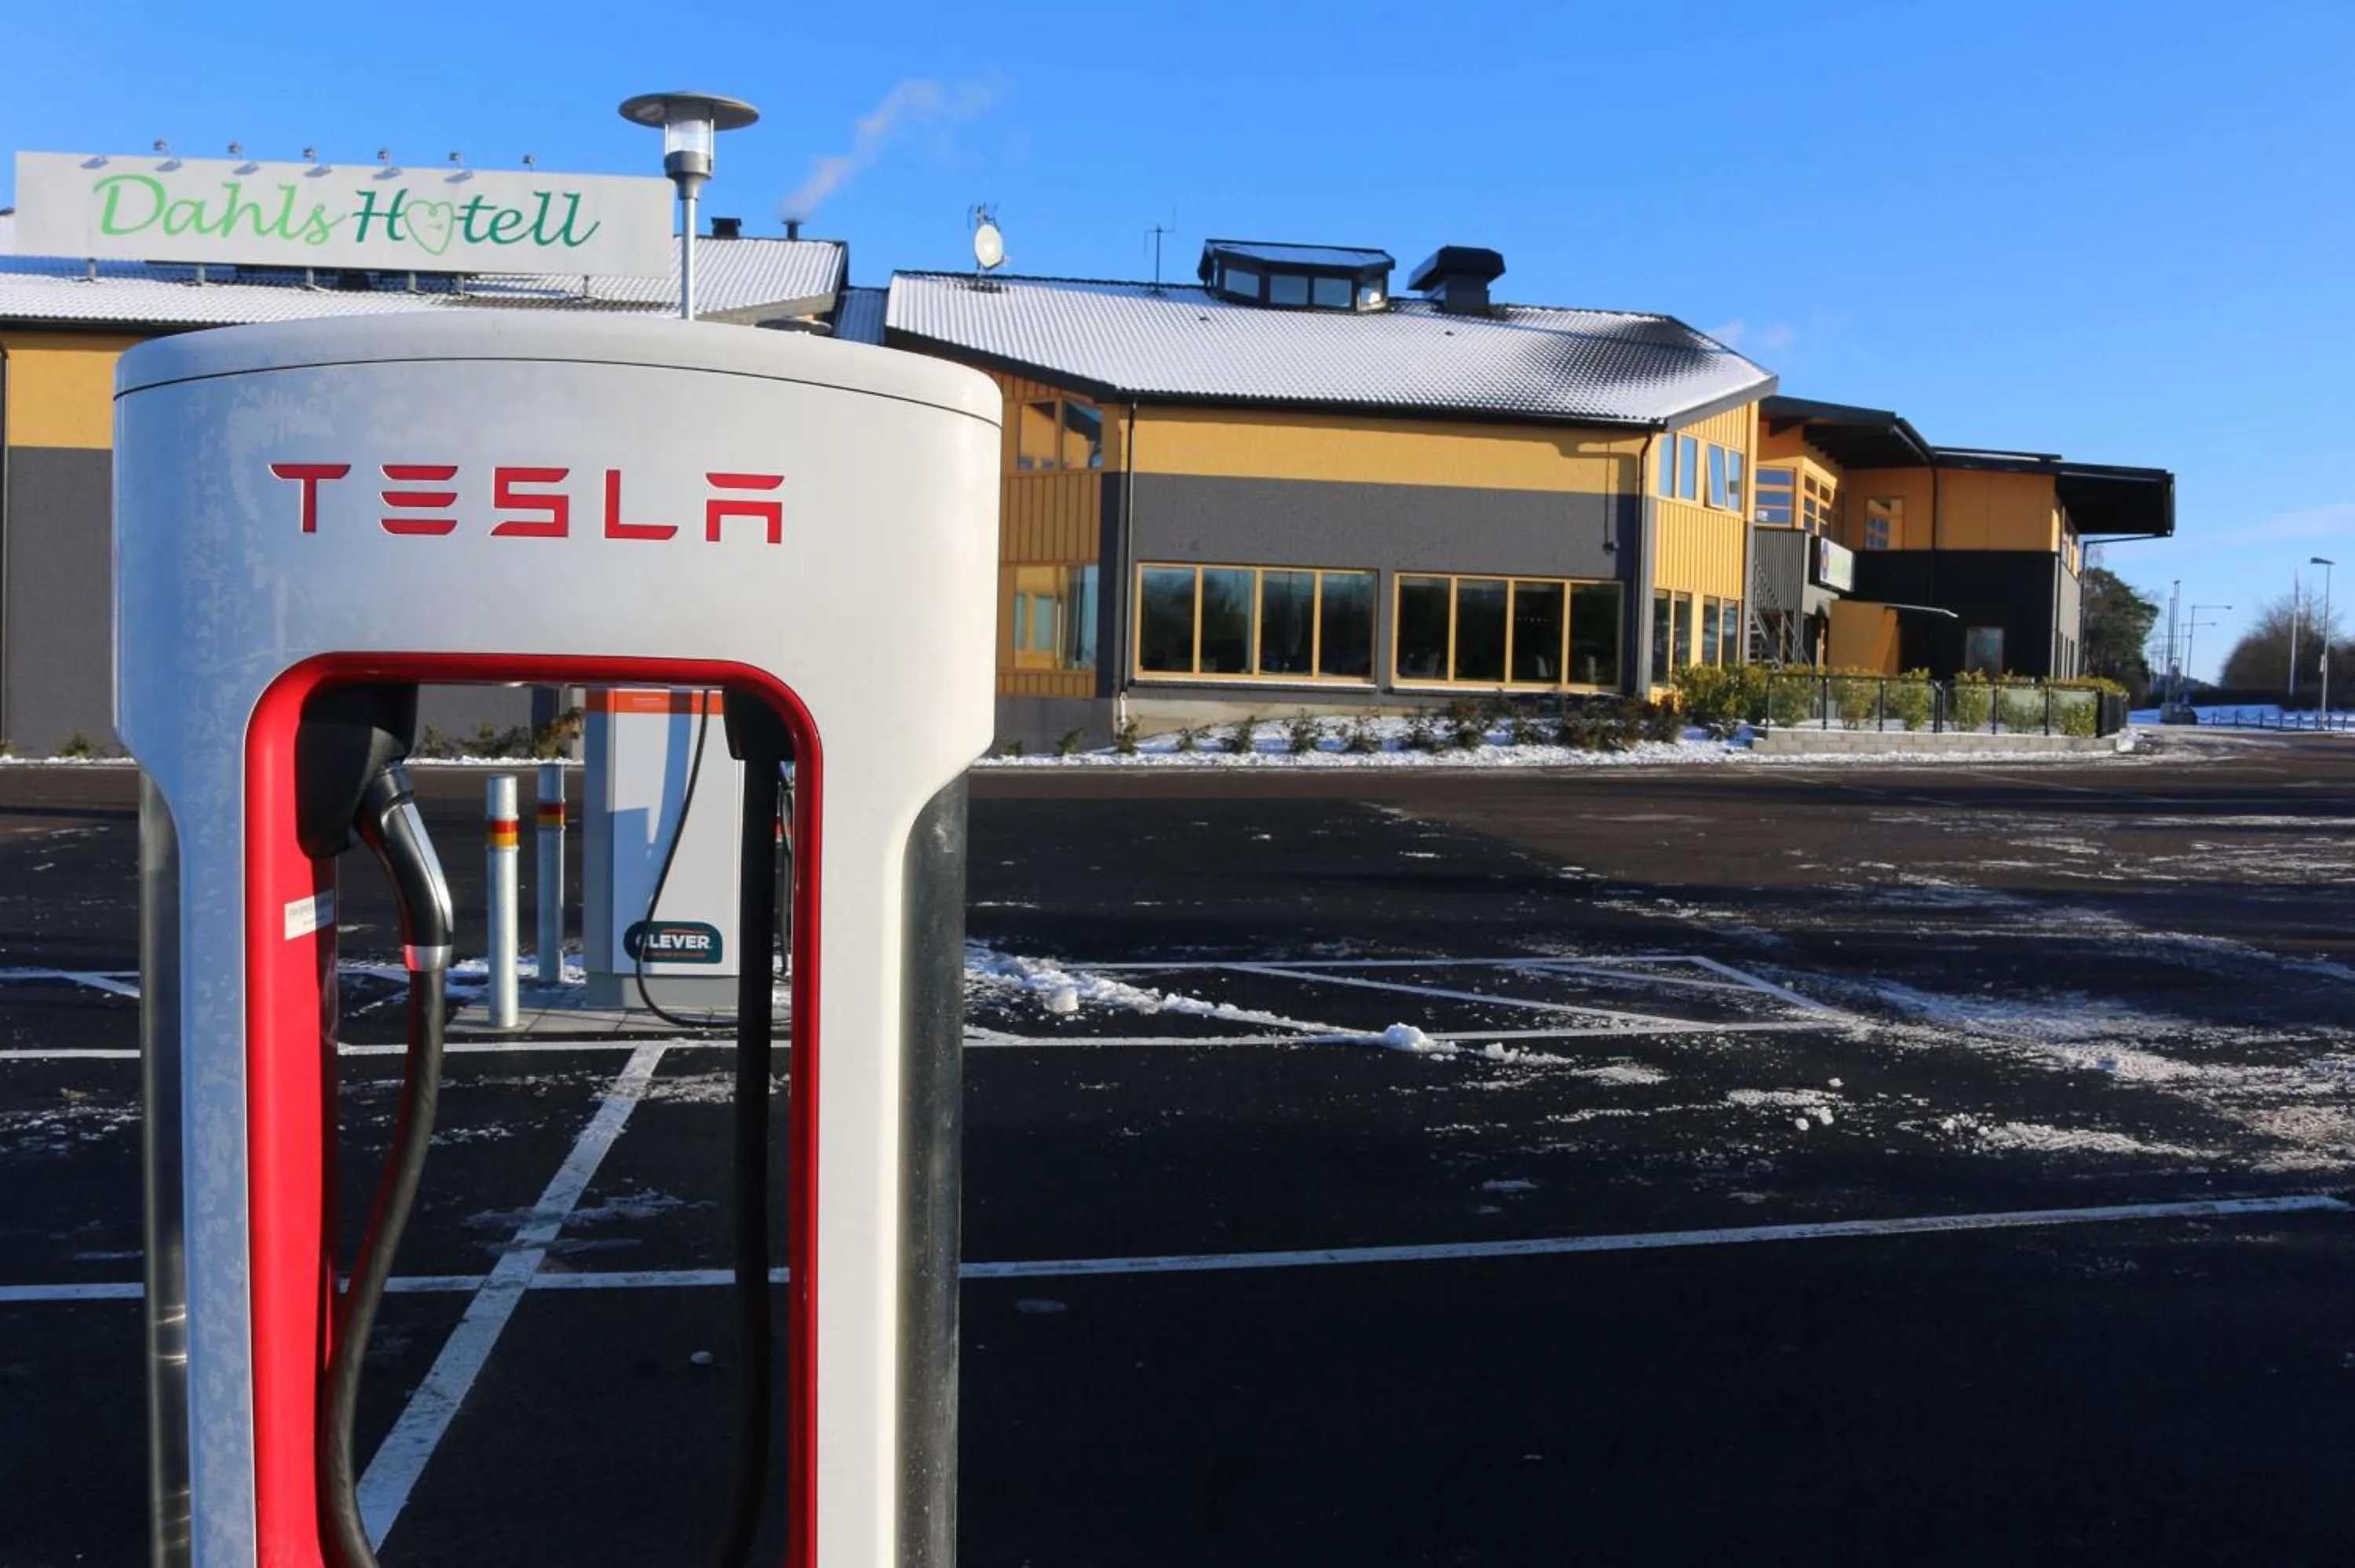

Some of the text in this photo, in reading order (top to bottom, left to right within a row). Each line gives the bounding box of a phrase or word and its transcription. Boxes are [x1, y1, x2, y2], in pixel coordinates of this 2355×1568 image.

[94, 173, 601, 256] Dahls Hotell
[268, 464, 784, 544] TESLA
